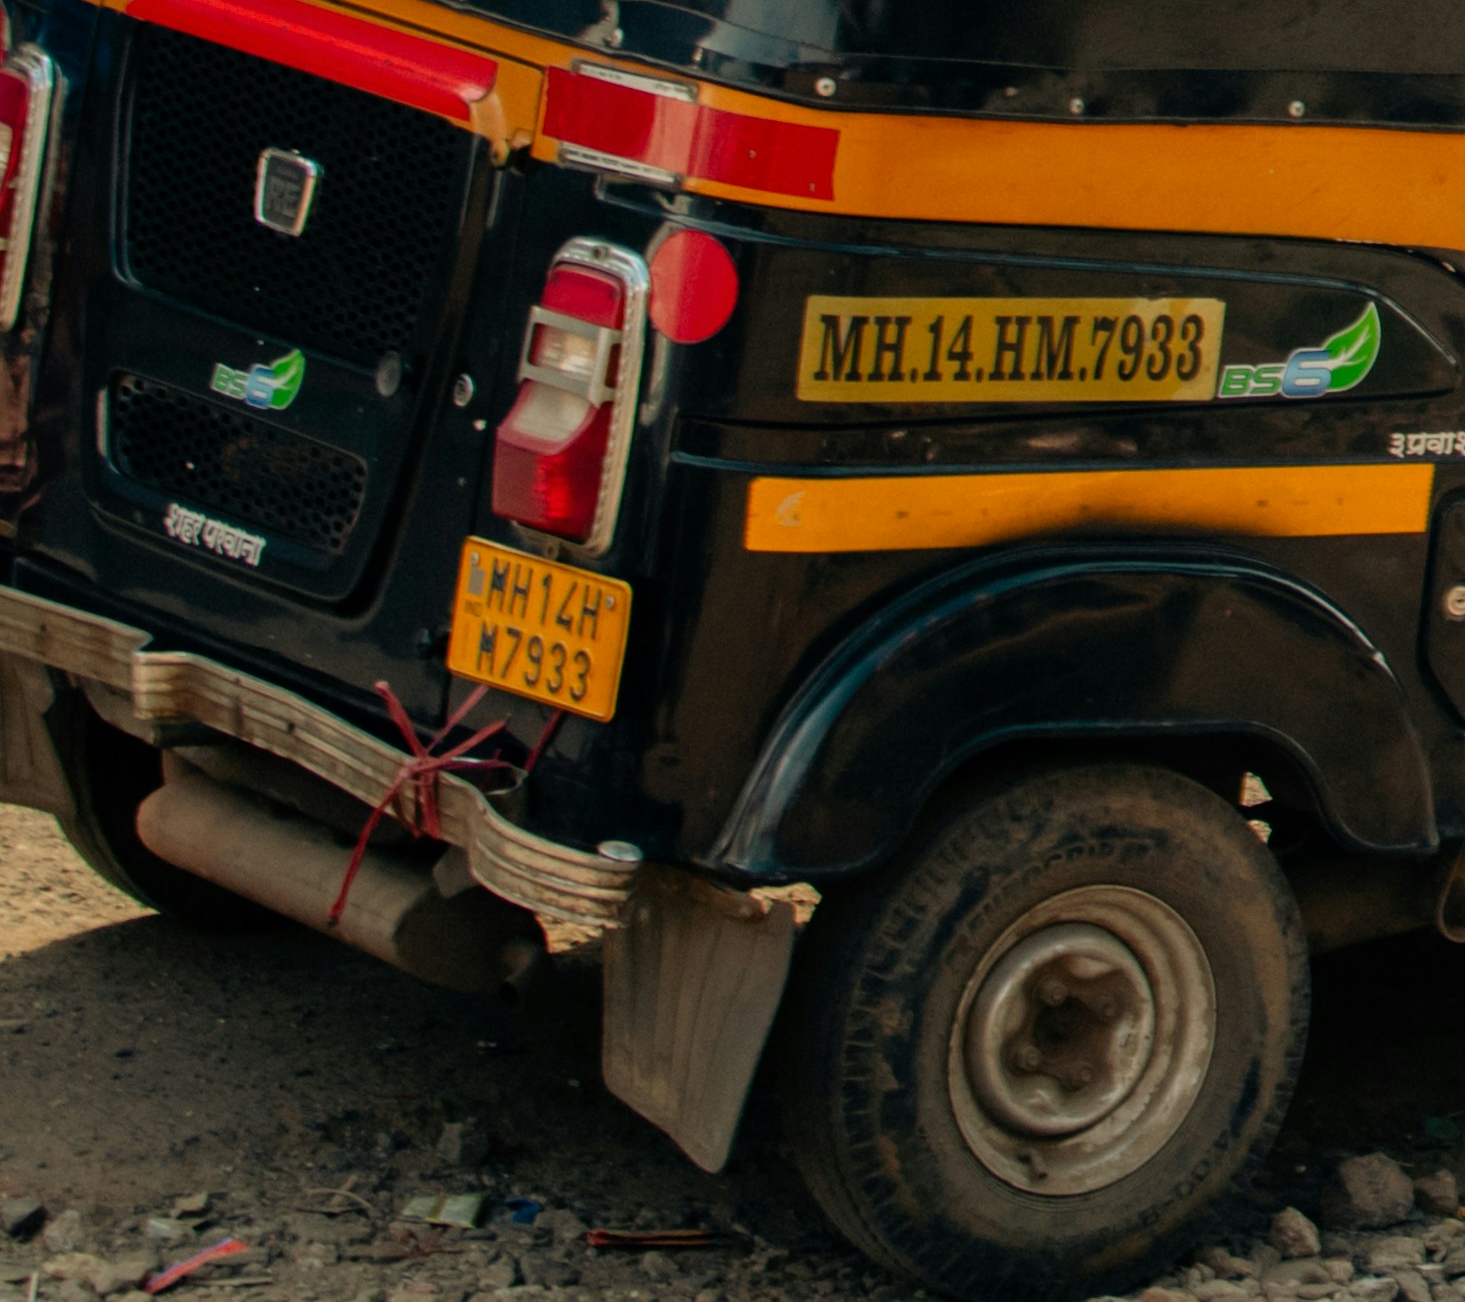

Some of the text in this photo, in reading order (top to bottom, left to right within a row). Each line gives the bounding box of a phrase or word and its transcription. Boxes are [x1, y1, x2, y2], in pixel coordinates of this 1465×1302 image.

[812, 311, 1206, 385] MH.14.HM.7933
[1219, 347, 1335, 398] BS6
[210, 362, 274, 410] BS6
[164, 502, 266, 567] शहर परवाना
[477, 619, 591, 702] M7933
